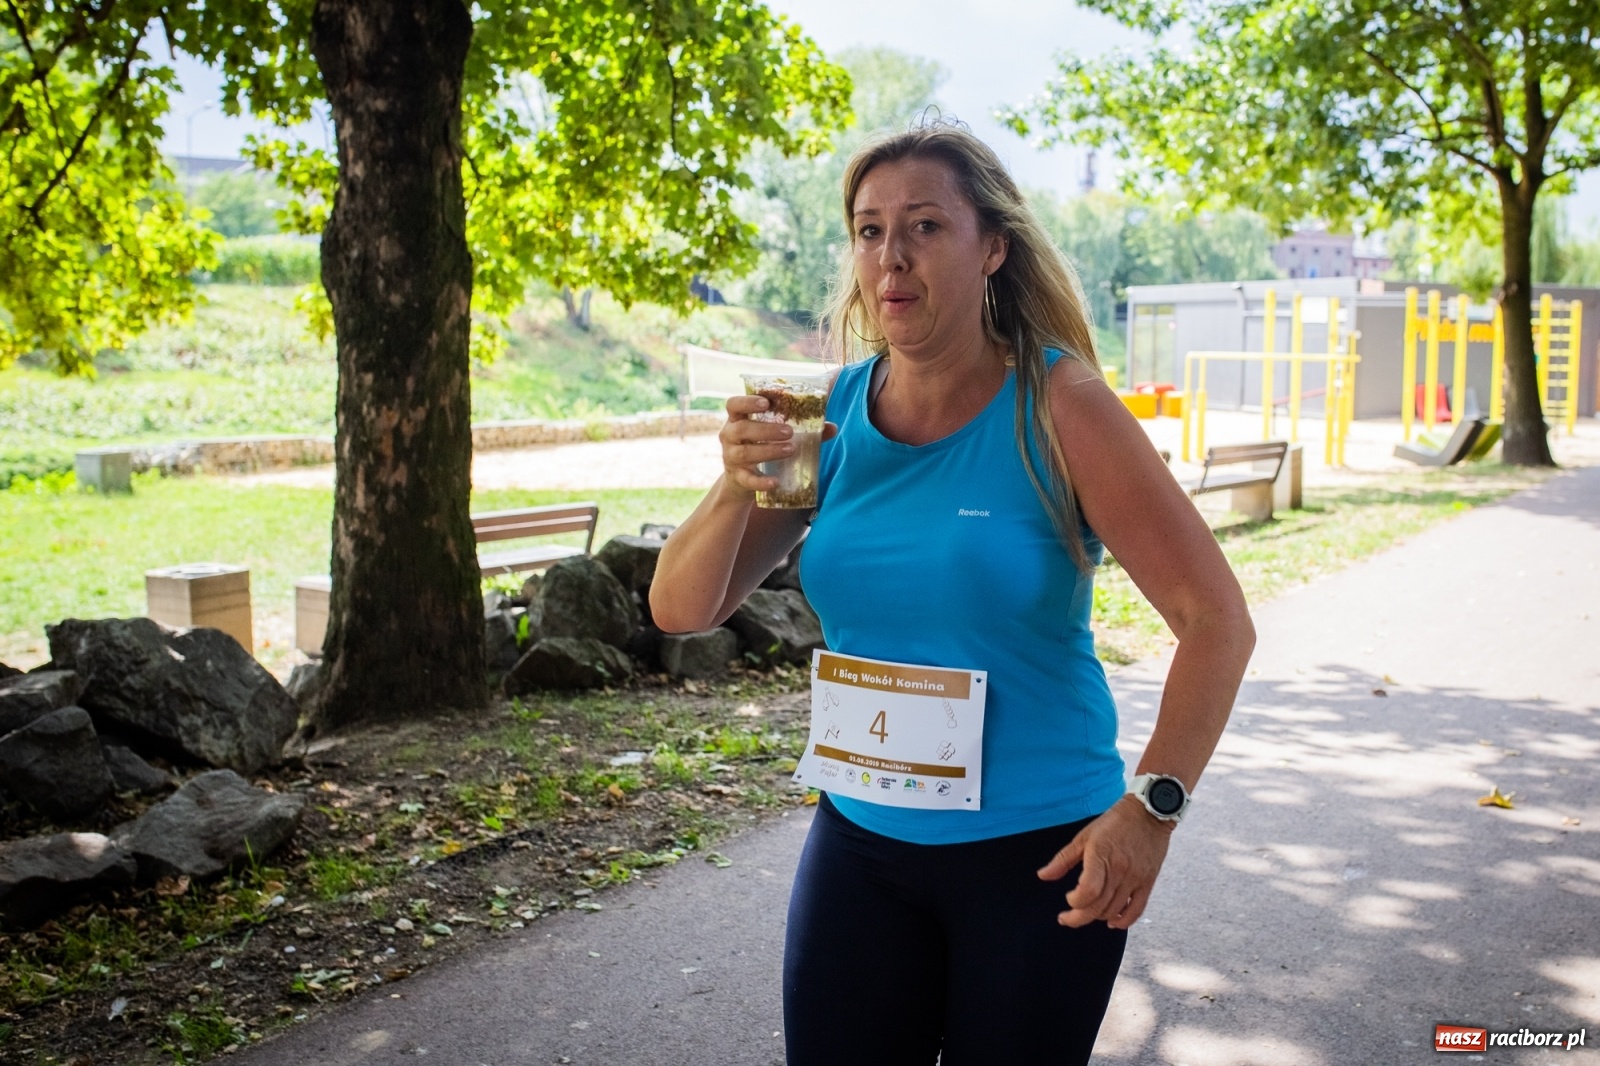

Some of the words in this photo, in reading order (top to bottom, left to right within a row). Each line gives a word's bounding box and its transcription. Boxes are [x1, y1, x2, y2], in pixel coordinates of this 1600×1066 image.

[958, 508, 991, 517] Reebok
[839, 669, 858, 683] Bieg
[861, 673, 893, 687] Wokół
[897, 678, 945, 691] Komina
[869, 710, 888, 744] 4
[880, 761, 912, 772] Racibórz
